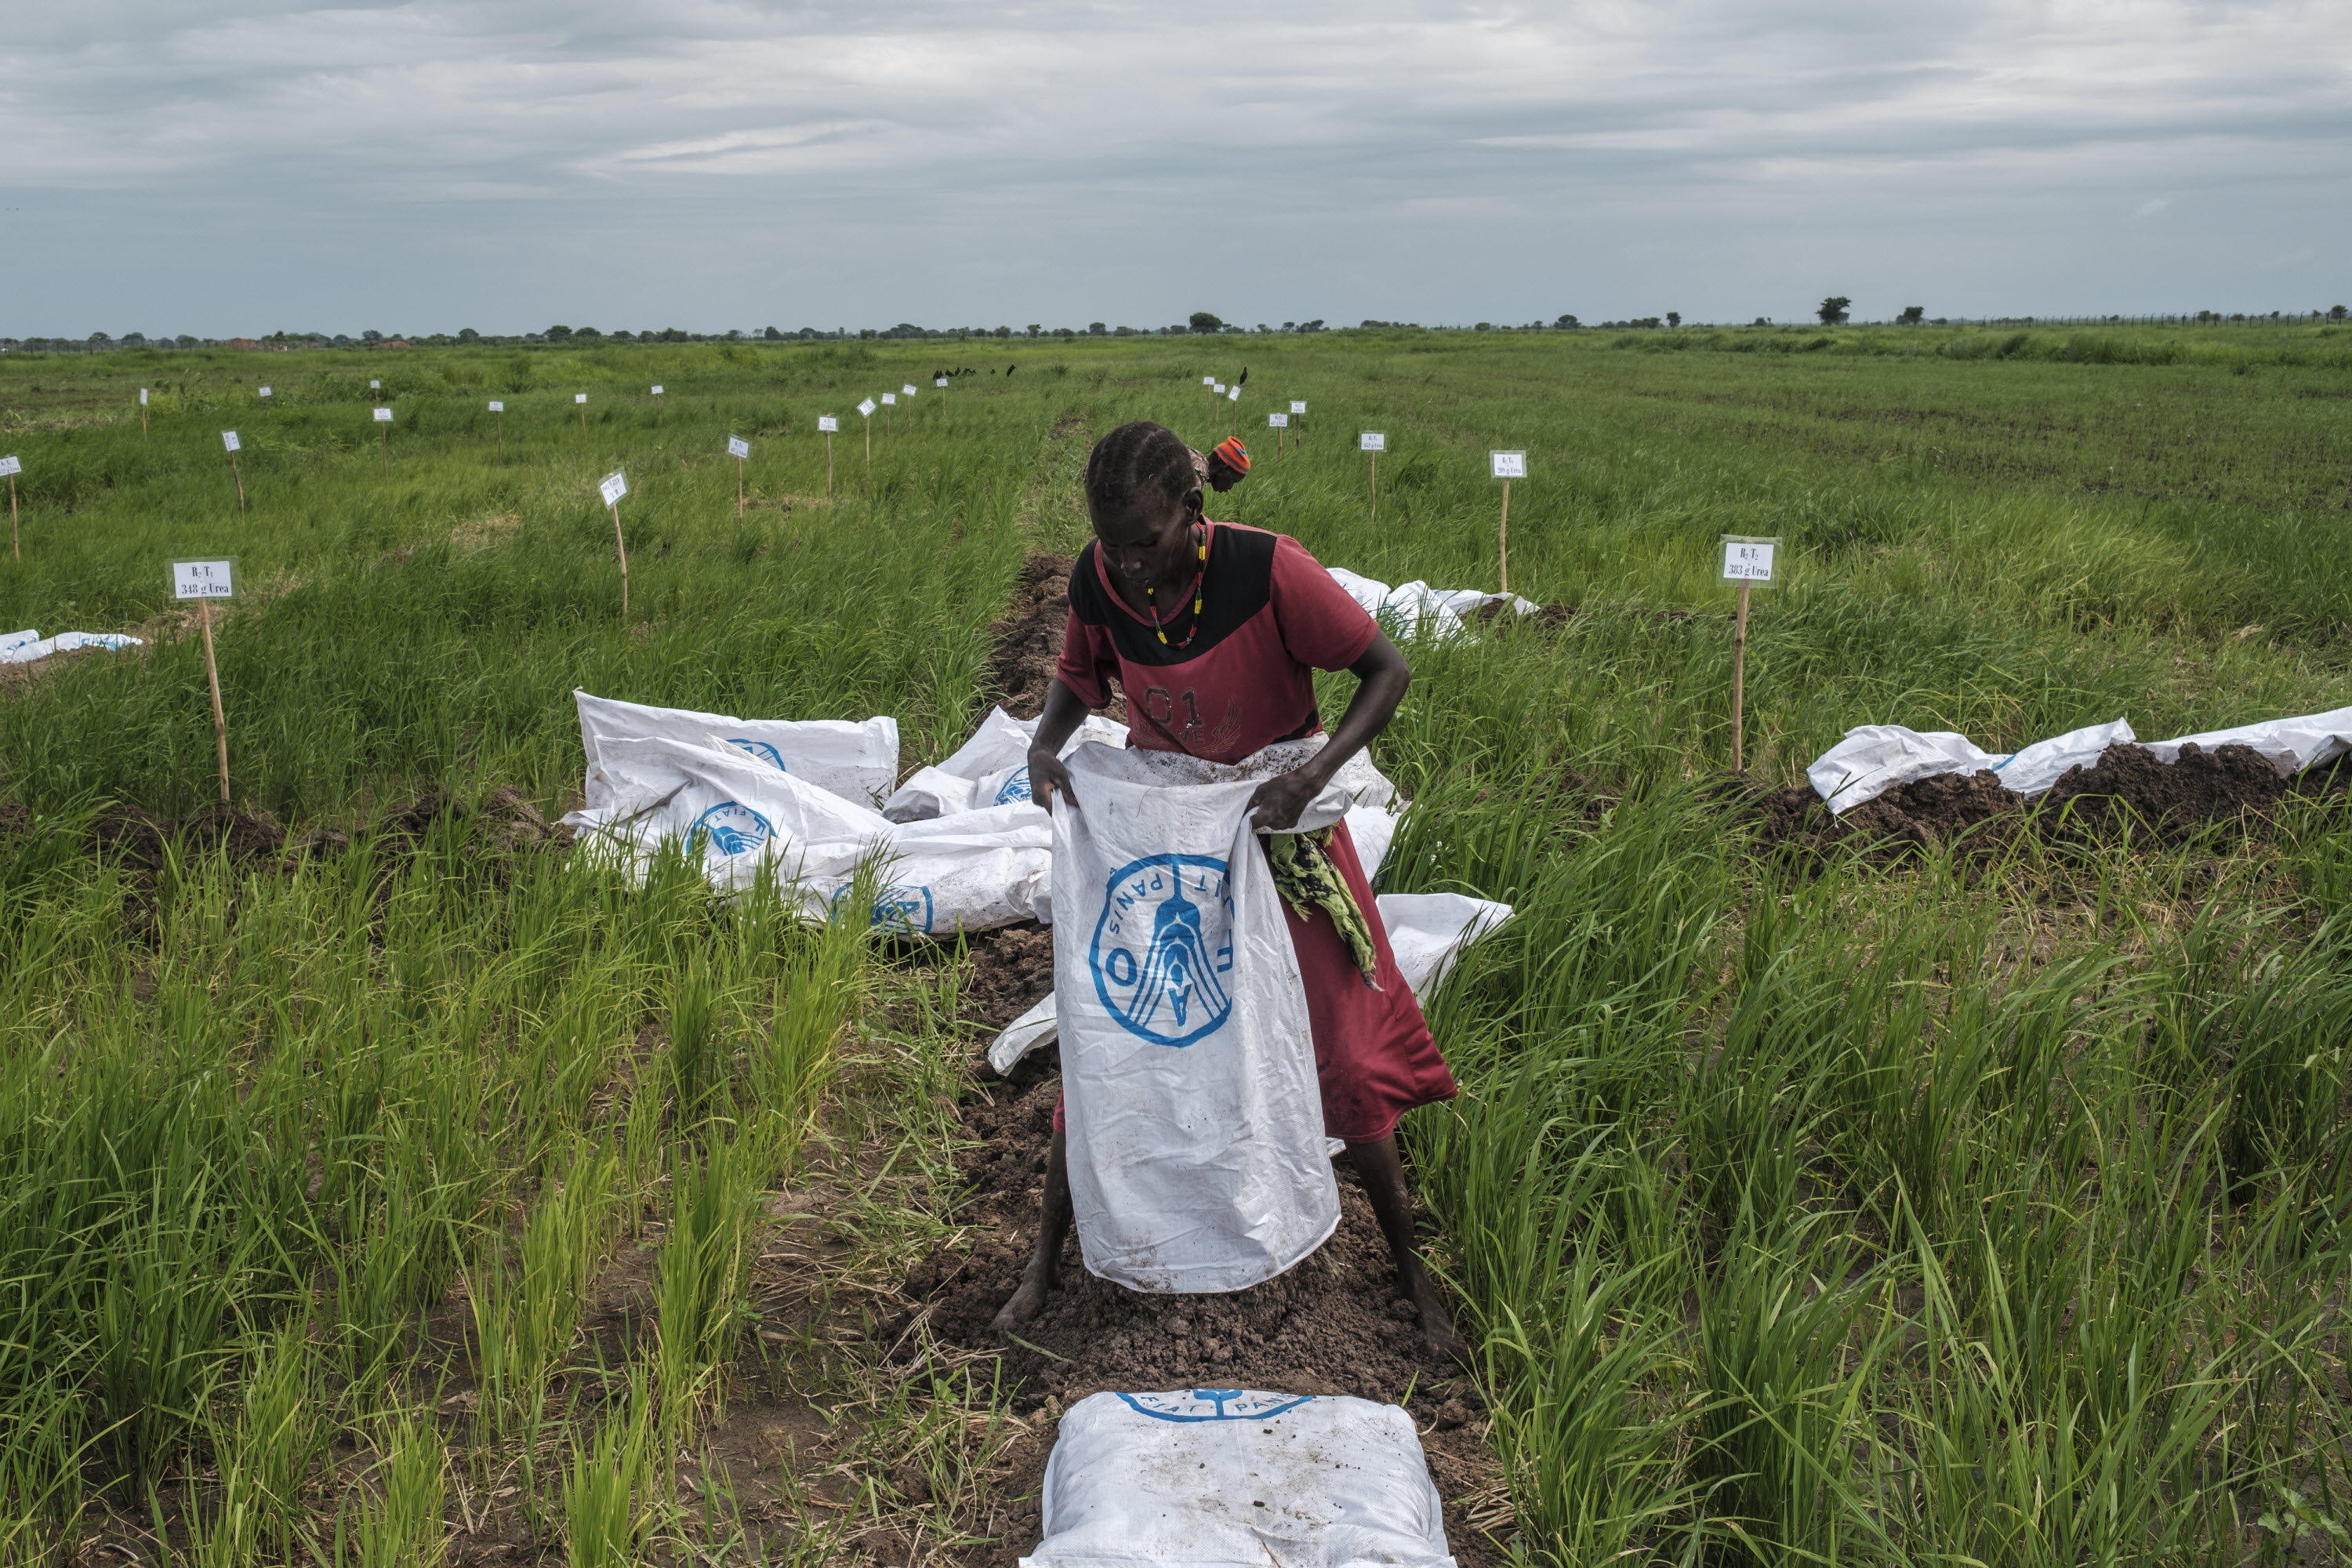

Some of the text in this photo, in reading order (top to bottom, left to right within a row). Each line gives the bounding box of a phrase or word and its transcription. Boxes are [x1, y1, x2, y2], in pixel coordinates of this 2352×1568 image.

[1728, 564, 1769, 578] 383 g Urea
[181, 583, 229, 596] 348 g Urea
[1109, 873, 1163, 934] PANIS
